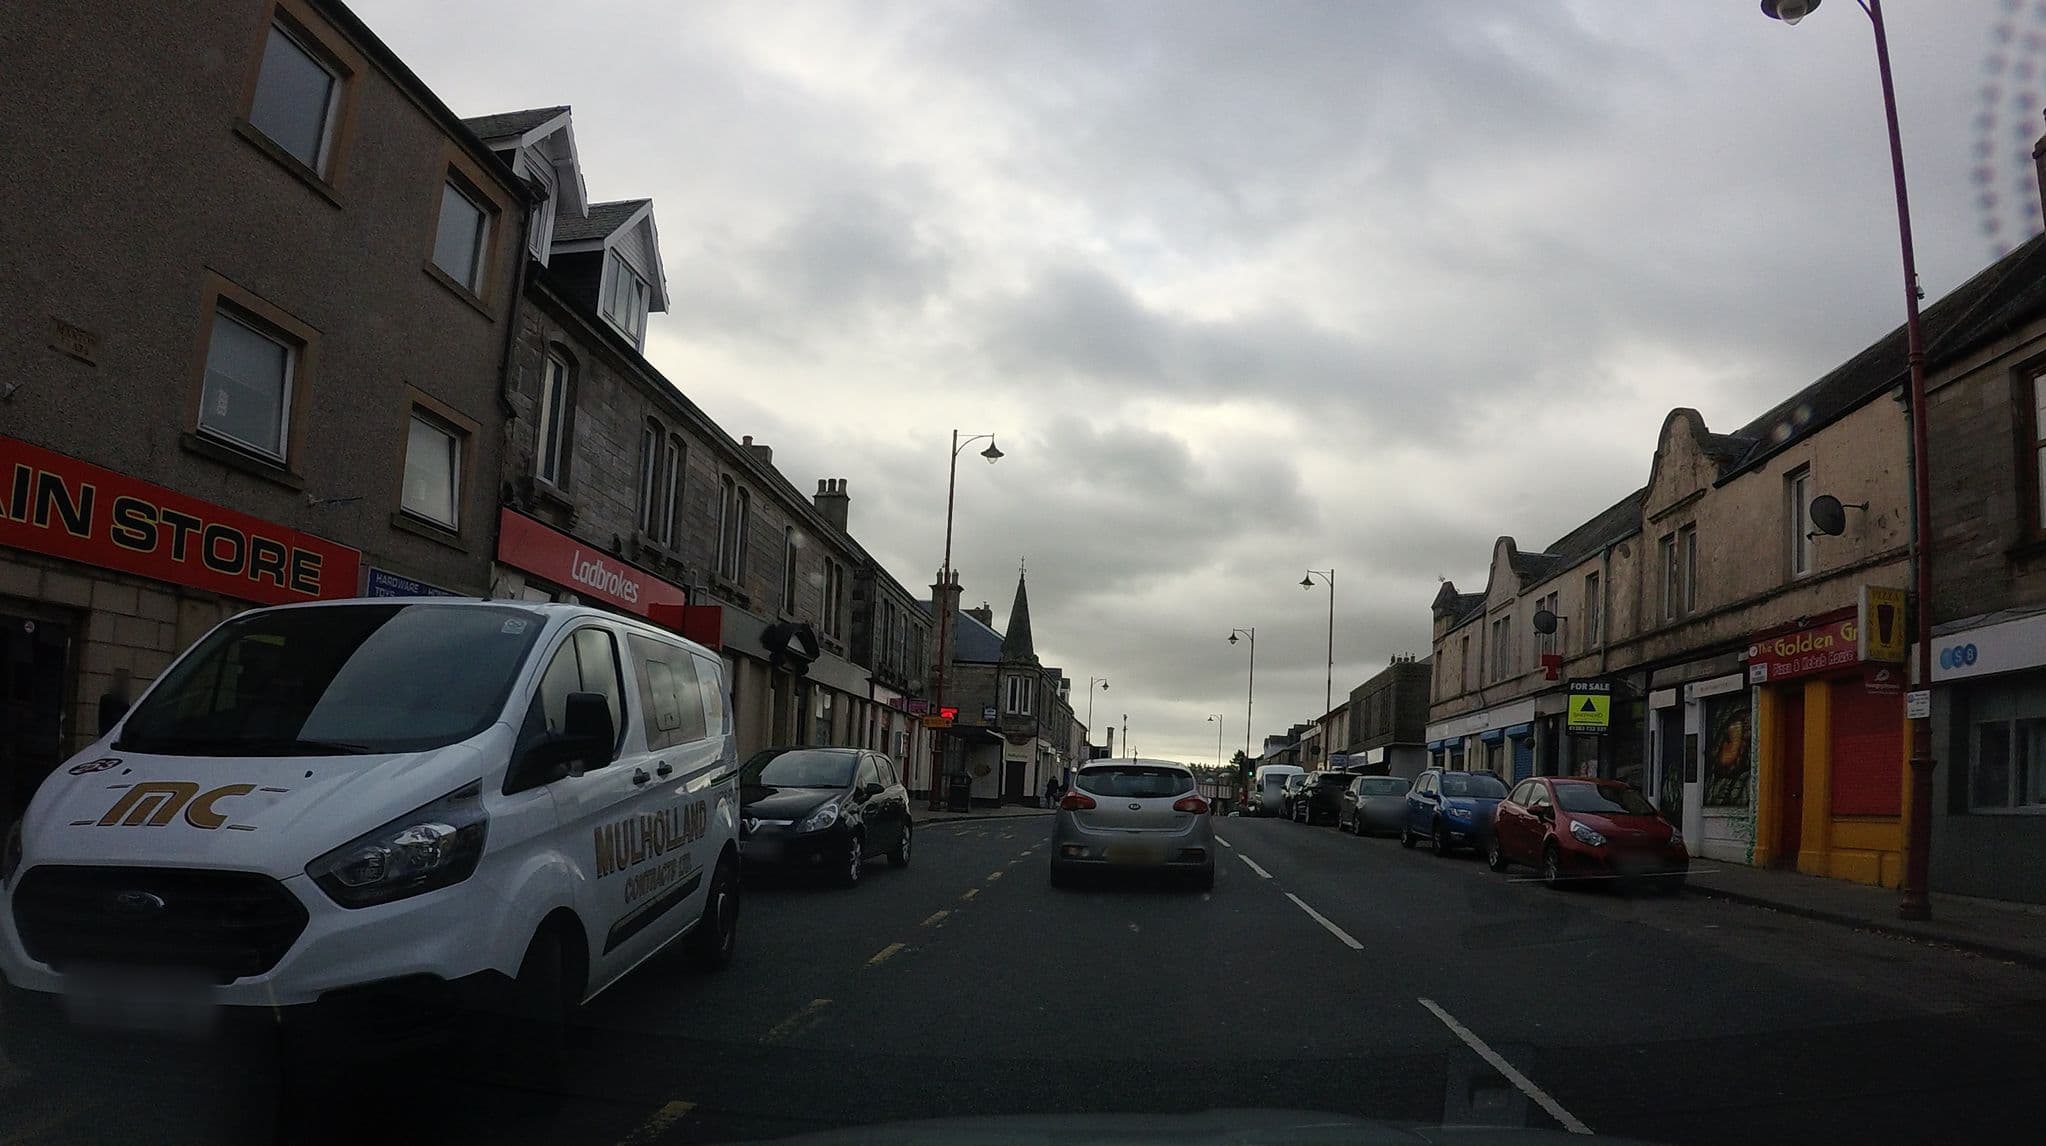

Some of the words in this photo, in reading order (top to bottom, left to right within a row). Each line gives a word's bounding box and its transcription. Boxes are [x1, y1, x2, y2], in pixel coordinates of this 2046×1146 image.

[0, 463, 96, 539] IN
[111, 496, 322, 596] STORE
[376, 573, 420, 593] HARDWARE
[571, 550, 640, 604] Ladbrokes
[1758, 643, 1773, 655] The
[1775, 631, 1834, 657] Golden
[1588, 683, 1610, 691] SALE
[97, 781, 258, 829] MC
[594, 799, 707, 880] MULHOLLAND
